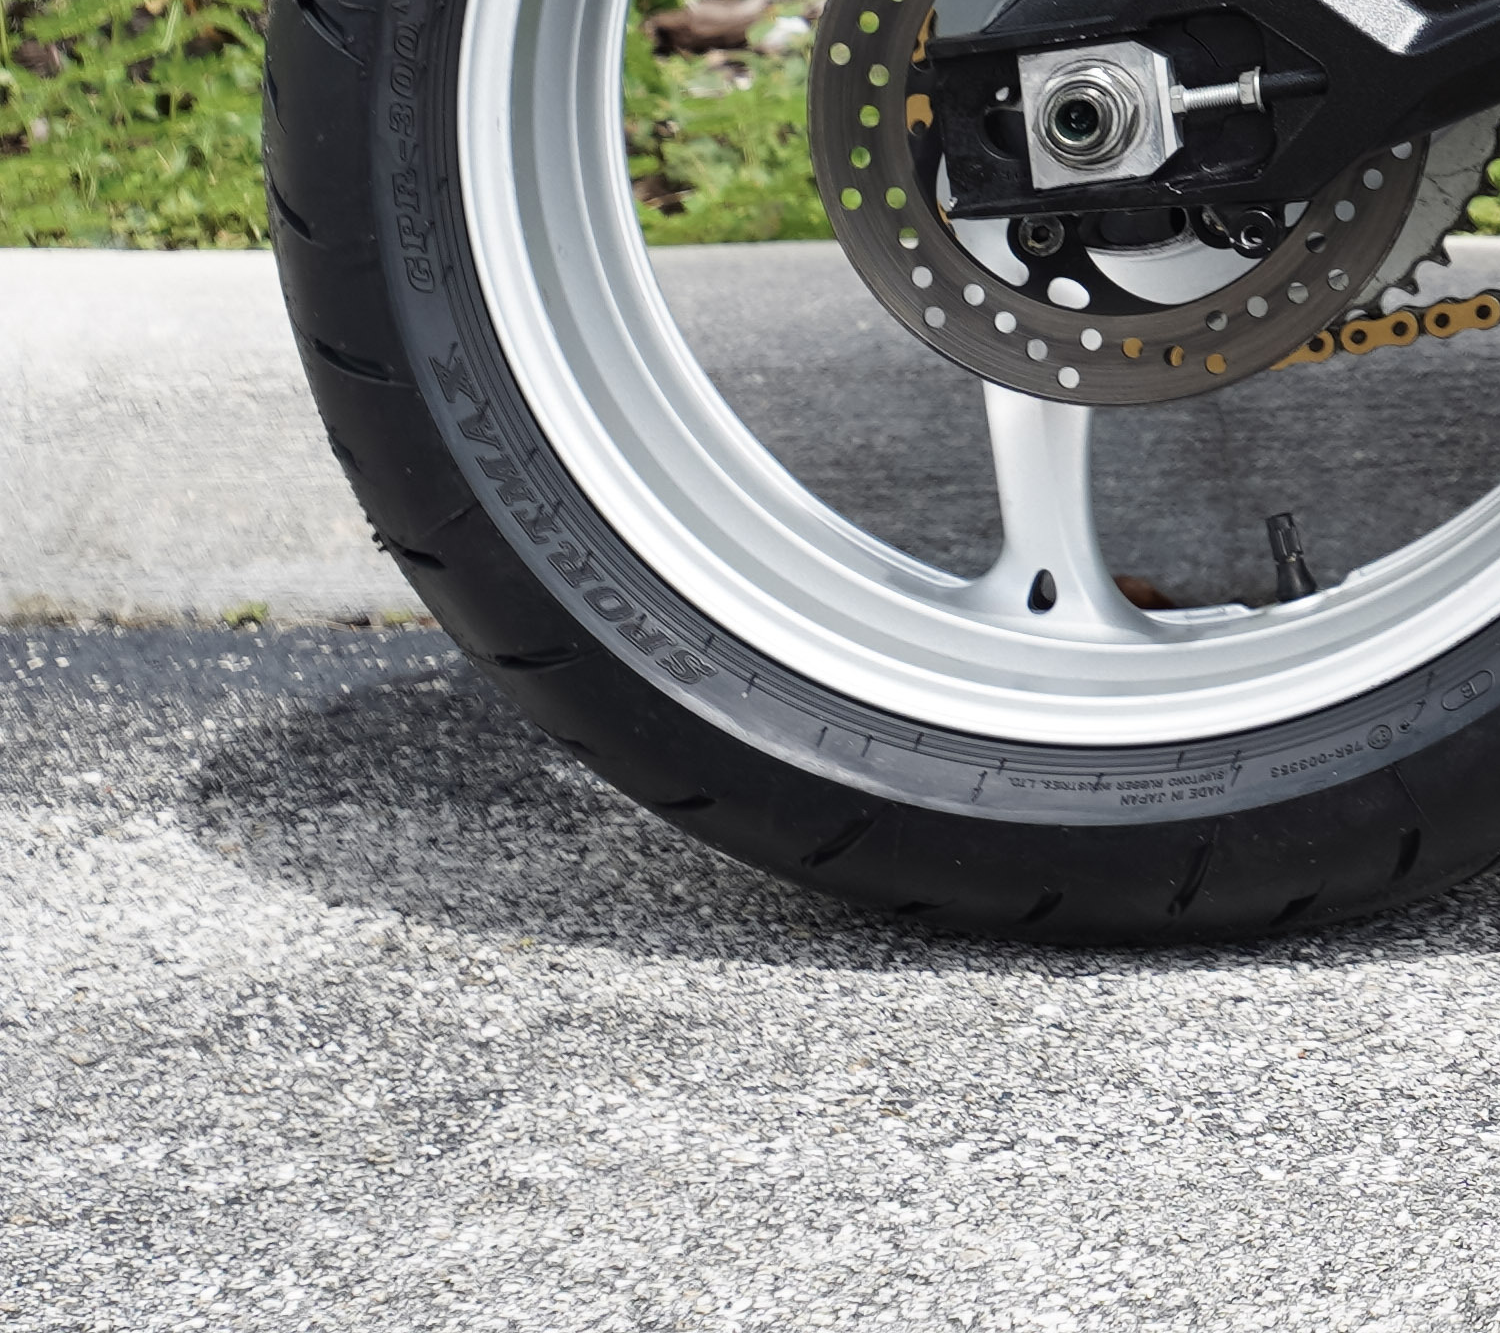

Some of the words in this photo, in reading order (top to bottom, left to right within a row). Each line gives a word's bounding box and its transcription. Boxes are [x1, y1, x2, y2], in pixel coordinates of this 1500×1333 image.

[387, 17, 441, 298] GPR-300
[428, 345, 719, 699] SPORTMAX
[1119, 789, 1167, 804] JAPAN
[1171, 788, 1185, 802] IN
[1187, 783, 1227, 800] MADE
